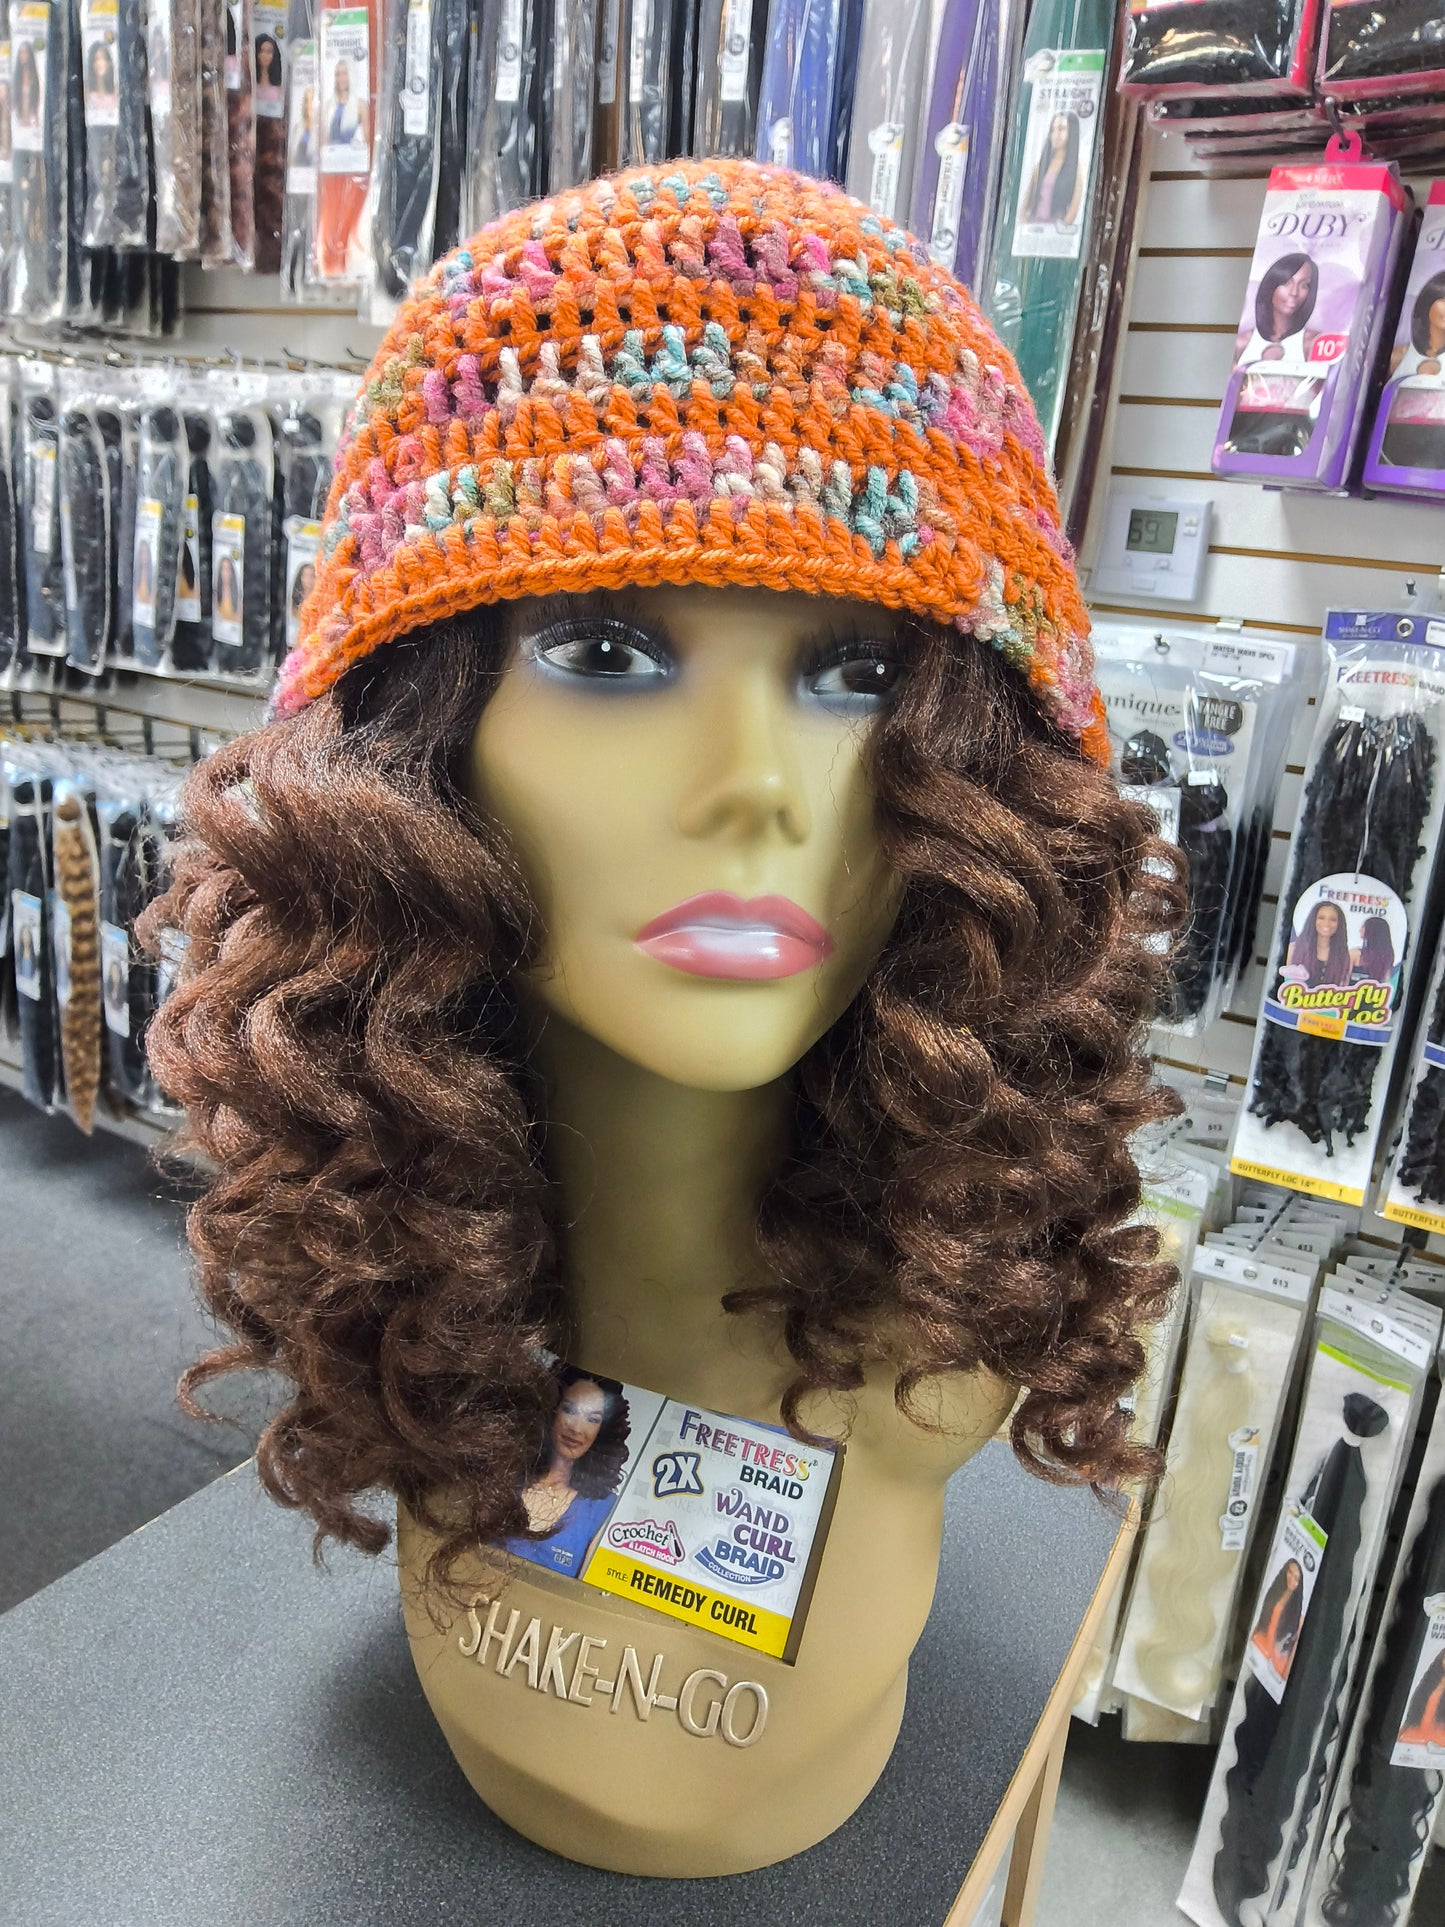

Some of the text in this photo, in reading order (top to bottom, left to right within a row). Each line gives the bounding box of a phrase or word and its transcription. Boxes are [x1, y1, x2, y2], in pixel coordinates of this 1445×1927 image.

[1040, 87, 1093, 99] STRAGHT
[1268, 211, 1367, 238] DUBY
[1318, 884, 1390, 908] FREETRESS
[1350, 904, 1387, 917] BRAID
[1282, 983, 1388, 1011] Butterfly
[1237, 1162, 1282, 1180] BUTTERFLY
[1281, 1174, 1299, 1185] LOC
[1392, 1207, 1438, 1227] BUTTERFLY
[1272, 1277, 1289, 1289] 613
[655, 1453, 702, 1496] 2X
[739, 1464, 804, 1500] BRAID
[716, 1487, 790, 1534] WAND
[612, 1524, 669, 1546] Crochet
[733, 1523, 796, 1564] CURL
[634, 1542, 656, 1557] LATCH
[655, 1551, 675, 1565] HOOK
[714, 1539, 785, 1580] BRAID
[708, 1561, 752, 1583] COLLECTION
[606, 1567, 629, 1582] STYLE:
[629, 1569, 708, 1613] REMEDY
[710, 1600, 758, 1636] CURL
[457, 1594, 769, 1748] SHAKE-N-GO
